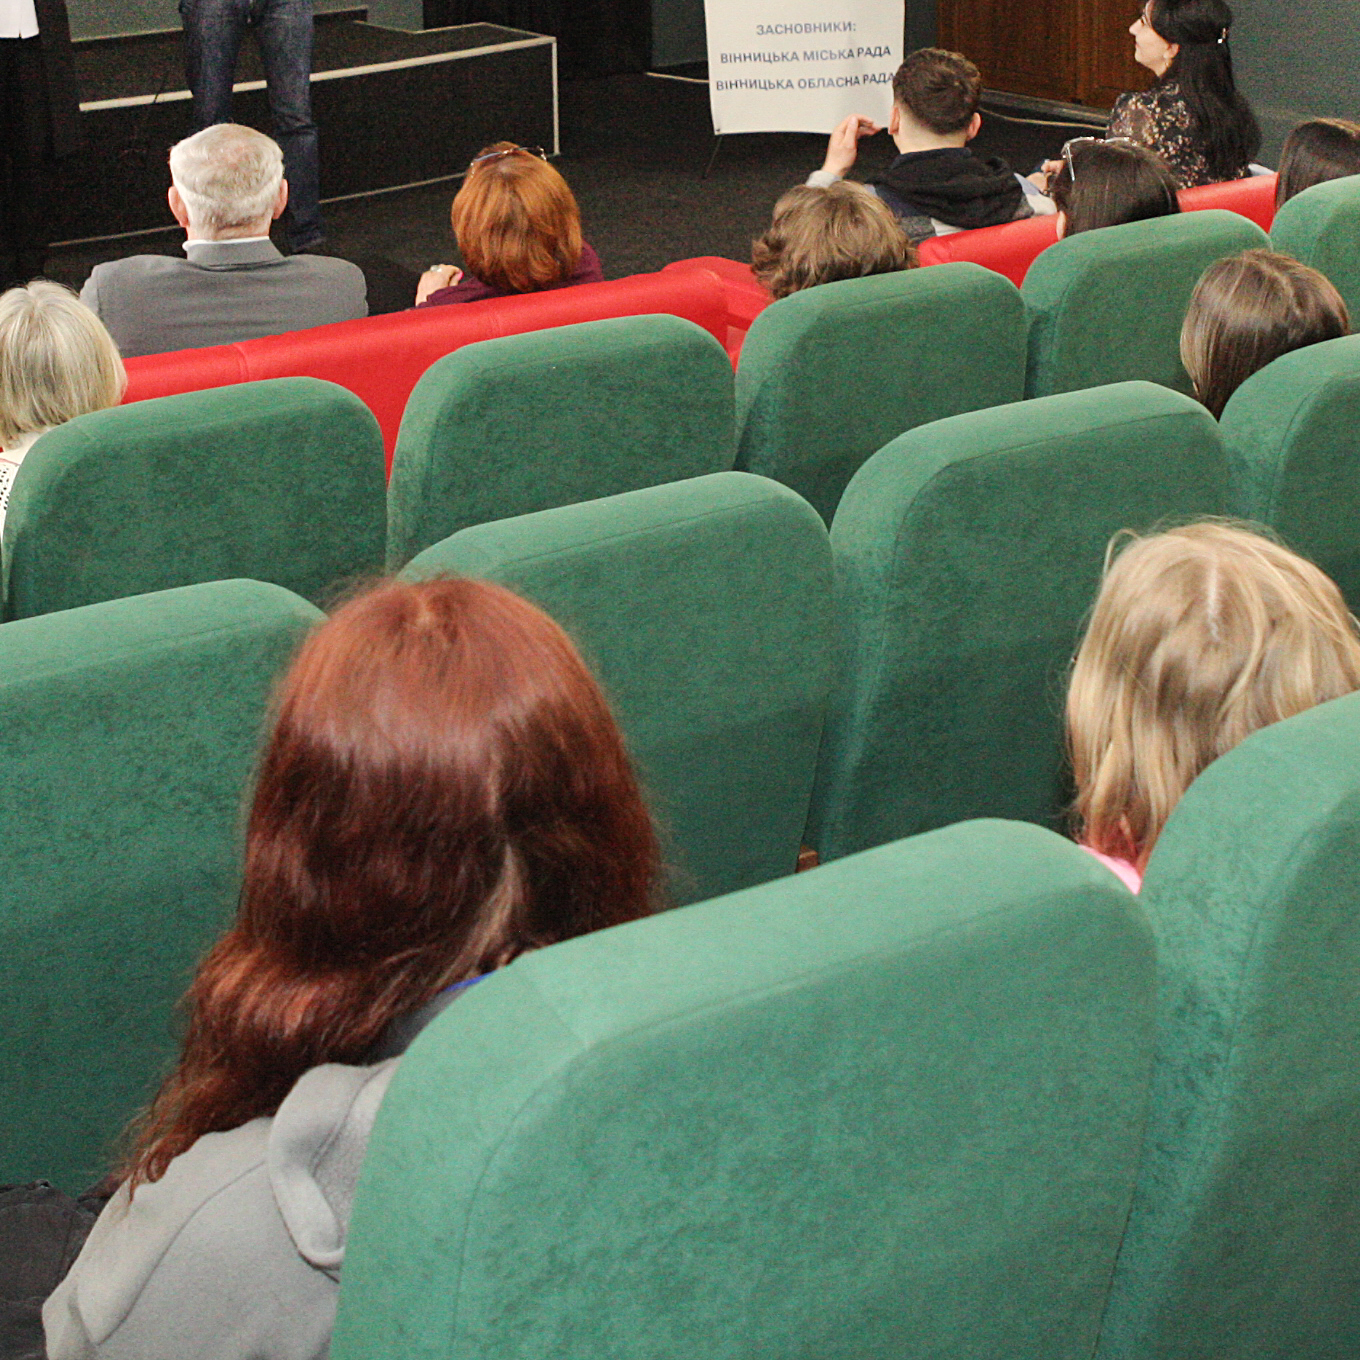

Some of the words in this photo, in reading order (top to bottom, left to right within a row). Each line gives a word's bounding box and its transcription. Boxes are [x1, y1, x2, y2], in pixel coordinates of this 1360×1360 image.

[756, 21, 857, 36] ЗАСНОВНИКИ:
[720, 51, 800, 64] ВІННИЦЬКА
[803, 48, 855, 62] МІСЬКА
[857, 45, 892, 59] РАДА
[716, 78, 794, 91] ВІННИЦЬКА
[798, 75, 860, 89] ОБЛАСНА
